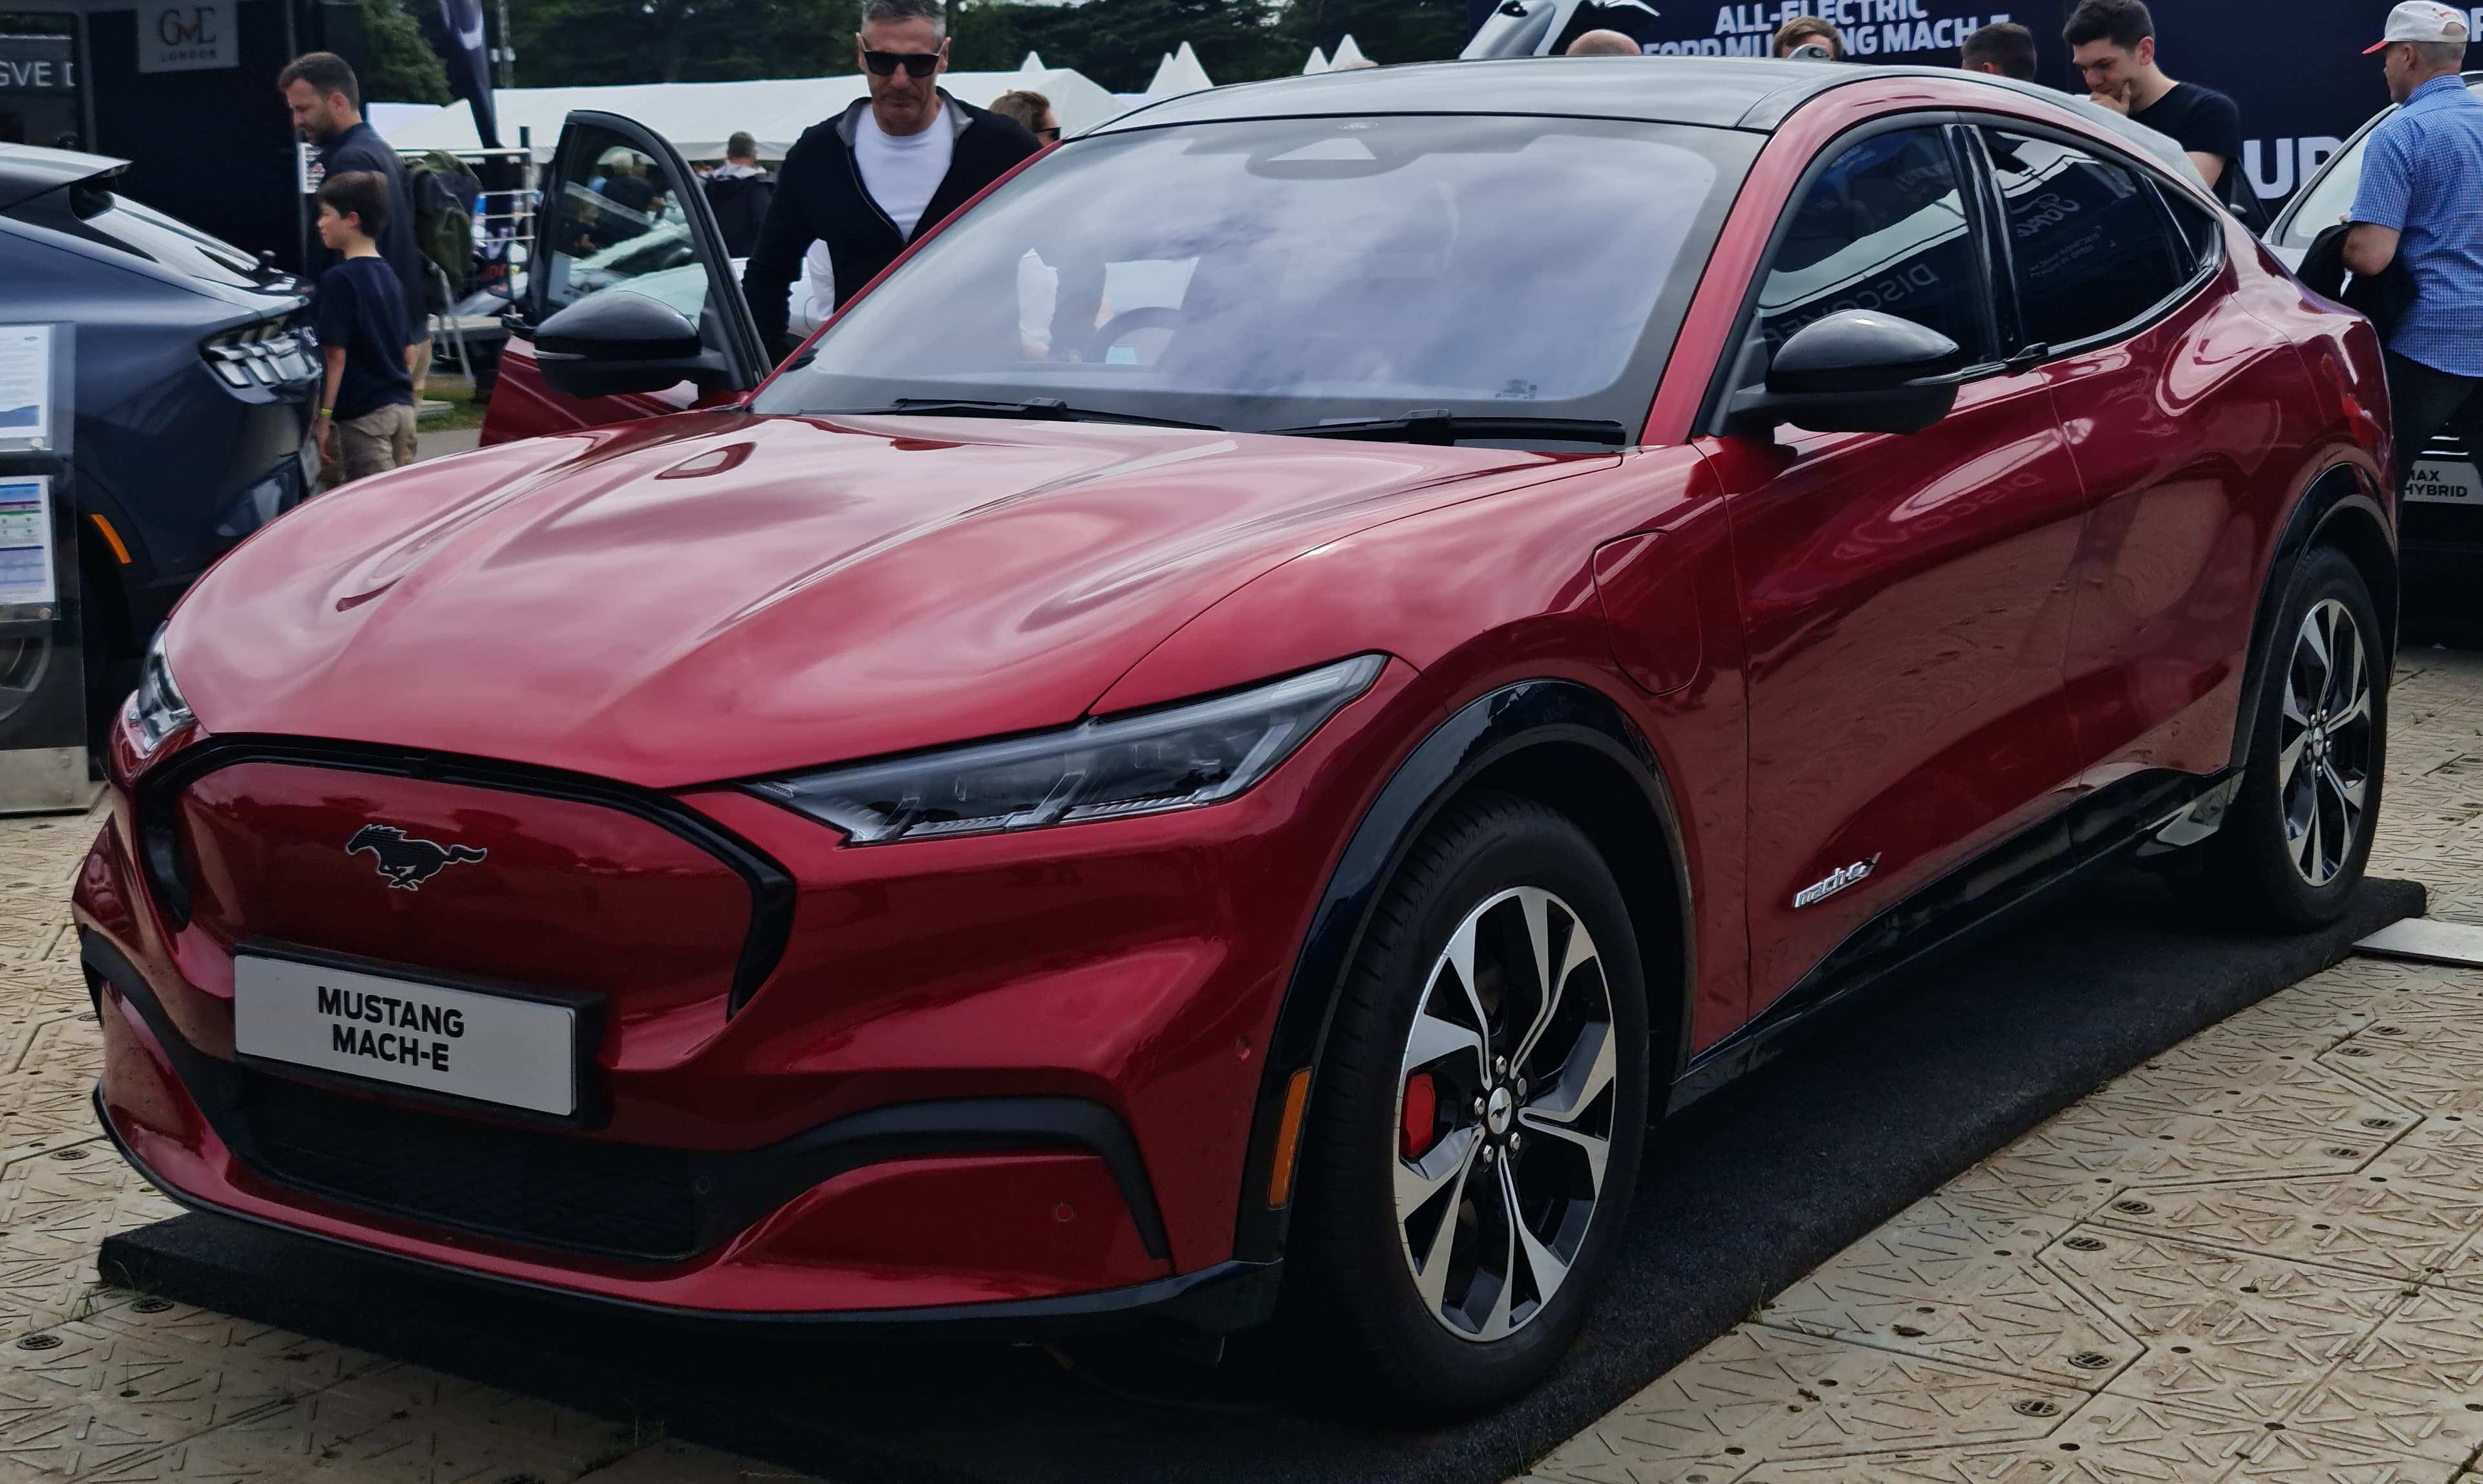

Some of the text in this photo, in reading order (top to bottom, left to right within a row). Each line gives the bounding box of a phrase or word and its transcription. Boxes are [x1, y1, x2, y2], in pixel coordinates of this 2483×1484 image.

[1725, 25, 1877, 58] MUNG
[1883, 14, 2010, 53] MACH
[2405, 484, 2468, 497] HYBRID
[317, 986, 464, 1038] MUSTANG
[333, 1024, 449, 1071] MACH-E
